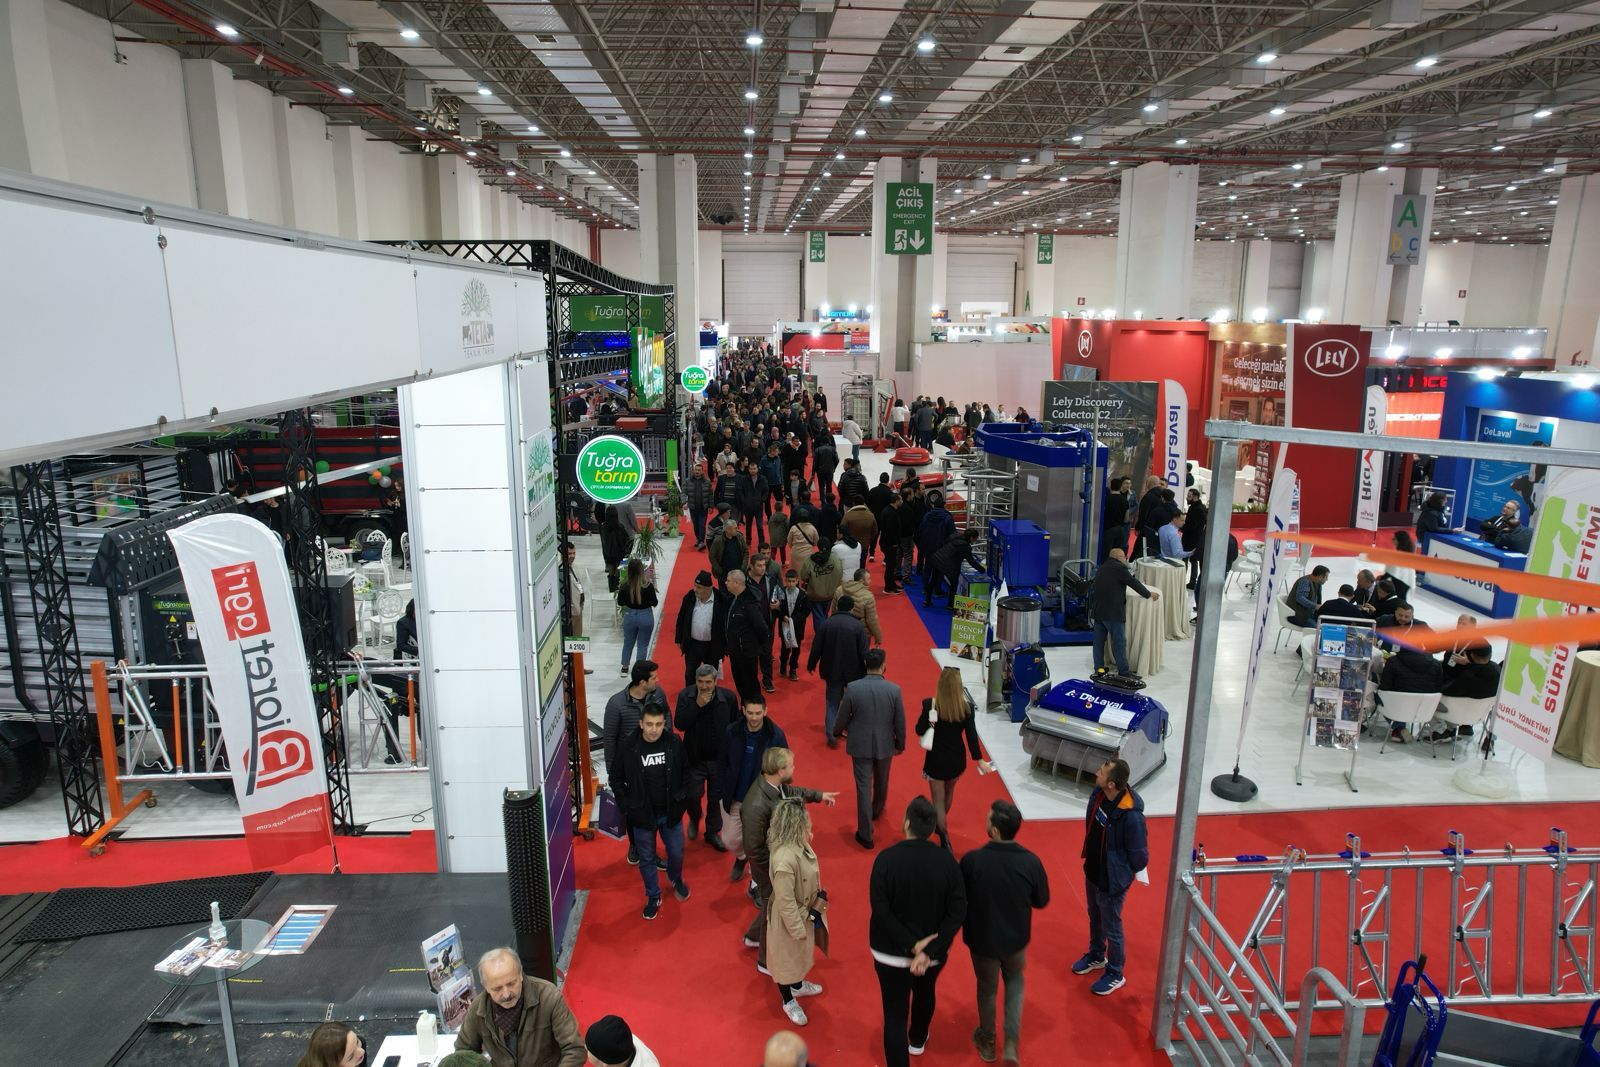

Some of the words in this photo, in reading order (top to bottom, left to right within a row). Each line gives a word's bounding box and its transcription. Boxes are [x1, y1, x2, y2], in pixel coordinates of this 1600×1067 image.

[898, 186, 922, 197] ACİL
[896, 198, 924, 209] ÇIKIŞ
[1397, 199, 1418, 228] A
[594, 305, 624, 319] Tuğra
[1315, 346, 1349, 369] LELY
[1233, 357, 1261, 373] Geleceği
[1261, 360, 1285, 374] parlak
[1262, 378, 1278, 390] sizin
[1053, 397, 1075, 408] Lely
[1075, 397, 1124, 409] Discovery
[1483, 427, 1512, 439] DeLaval
[586, 452, 634, 472] Tuğra
[594, 470, 638, 483] tarım
[953, 624, 983, 635] DRENCH
[1544, 644, 1570, 713] SÜRÜ
[1079, 692, 1125, 710] DeLaval
[1518, 711, 1552, 735] YÖNETİMİ
